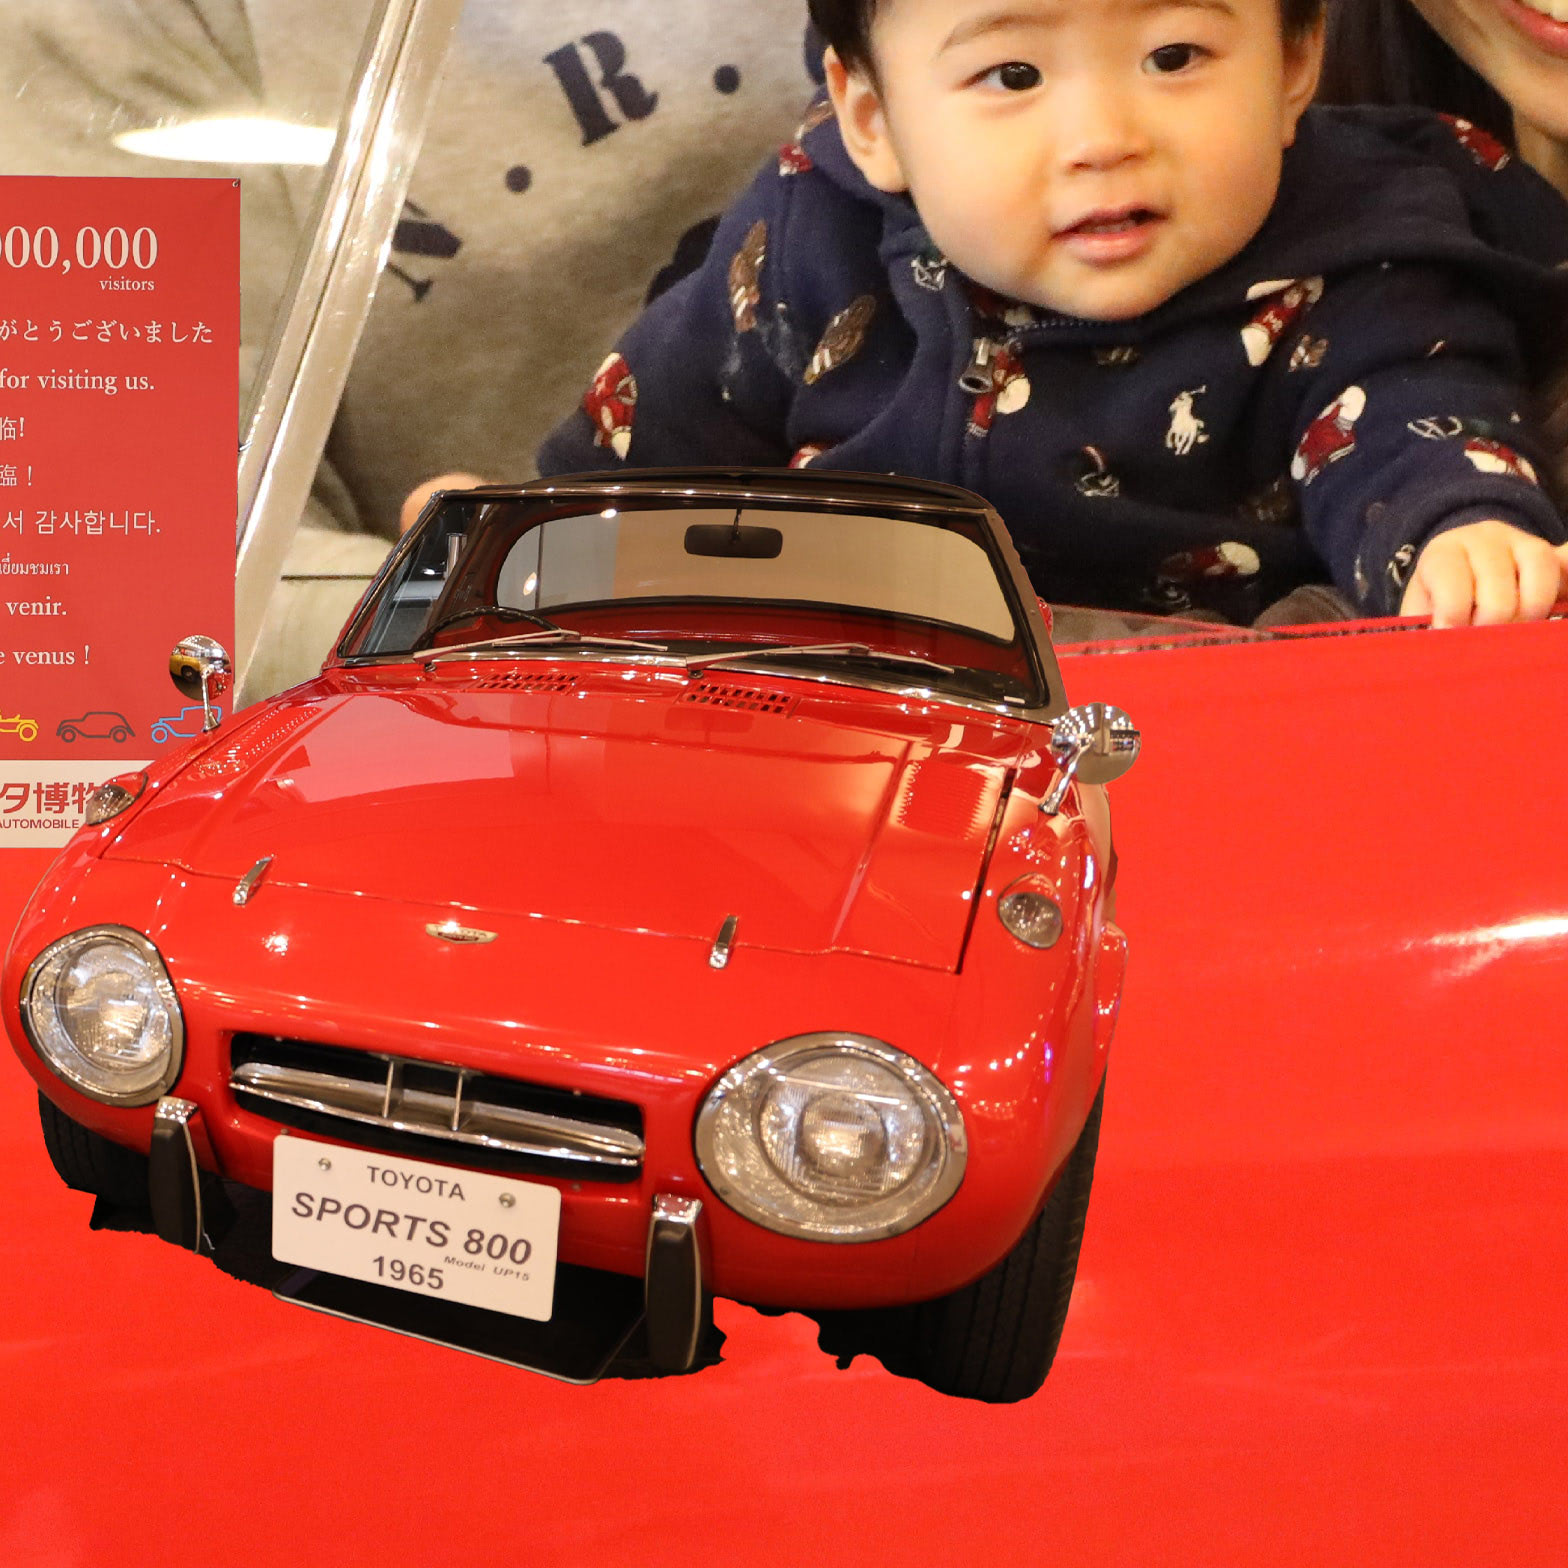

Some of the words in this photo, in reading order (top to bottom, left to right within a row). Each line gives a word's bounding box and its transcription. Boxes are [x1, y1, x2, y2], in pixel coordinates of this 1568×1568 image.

[99, 275, 155, 291] visitors
[37, 368, 118, 395] visiting
[125, 376, 155, 390] us.
[35, 509, 161, 536] 감사합니다.
[5, 595, 68, 616] venir.
[12, 651, 75, 665] venus
[366, 1165, 466, 1202] TOYOTA
[291, 1192, 452, 1248] SPORTS
[463, 1228, 533, 1266] 800
[372, 1255, 445, 1291] 1965
[443, 1255, 486, 1272] Model
[492, 1266, 530, 1282] UP15
